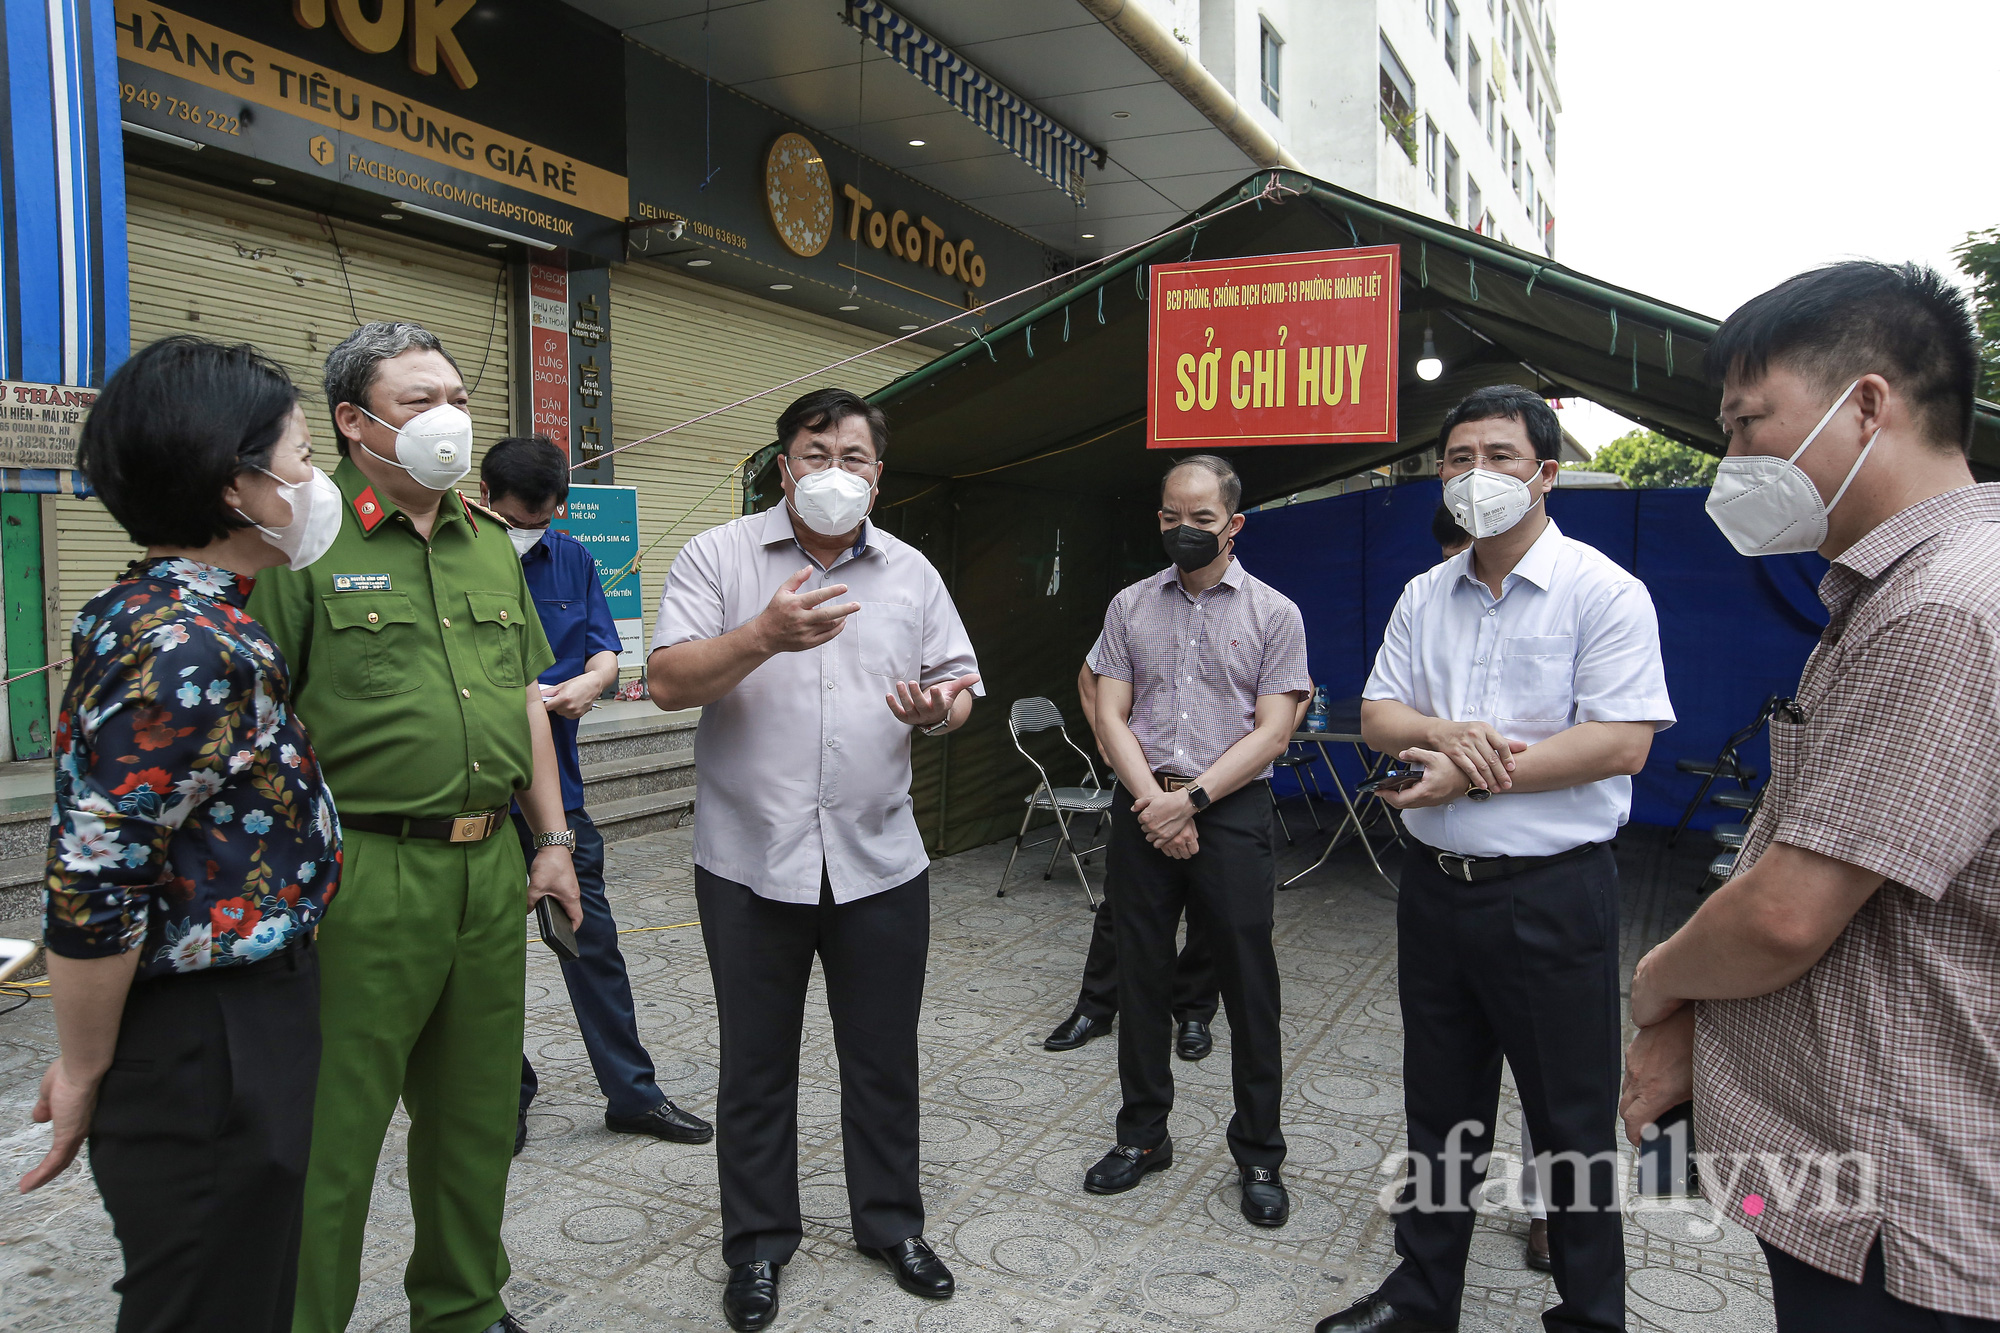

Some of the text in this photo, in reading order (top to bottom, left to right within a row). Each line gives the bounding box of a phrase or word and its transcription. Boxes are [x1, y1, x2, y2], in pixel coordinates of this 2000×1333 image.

[114, 7, 577, 196] HÀNG TIÊU DÙNG GIÁ RẺ
[166, 96, 202, 125] 736
[206, 110, 240, 137] 222
[348, 154, 574, 237] FACEBOOK.COM/CHEAPSTORE10K
[692, 221, 714, 238] 1900
[715, 228, 747, 250] 636936
[530, 265, 567, 286] Cheap
[1166, 270, 1382, 311] BCĐ PHÒNG, CHỐNG DỊCH COVID-19 PHƯỜNG HOÀNG LIỆT
[533, 301, 565, 316] PHỤ KIỆN
[575, 321, 604, 333] Macchiato
[544, 338, 558, 352] ỐP
[538, 355, 563, 370] LƯNG
[1175, 325, 1368, 412] SỞ CHỈ HUY
[535, 371, 568, 385] BAO DA
[583, 379, 599, 389] Fresh
[13, 386, 98, 408] THÀNH
[580, 386, 603, 397] fruit tea
[541, 397, 561, 411] DÁN
[42, 408, 60, 423] MÁI
[62, 407, 79, 424] XẾP
[535, 411, 568, 427] CƯỜNG
[12, 422, 36, 433] QUAN
[38, 425, 57, 436] HOA,
[59, 426, 70, 436] HN
[16, 435, 76, 451] 3828.7390
[581, 441, 593, 450] Milk
[570, 501, 586, 510] ĐIỂM
[571, 510, 583, 520] THẺ
[592, 533, 605, 542] ĐỔI
